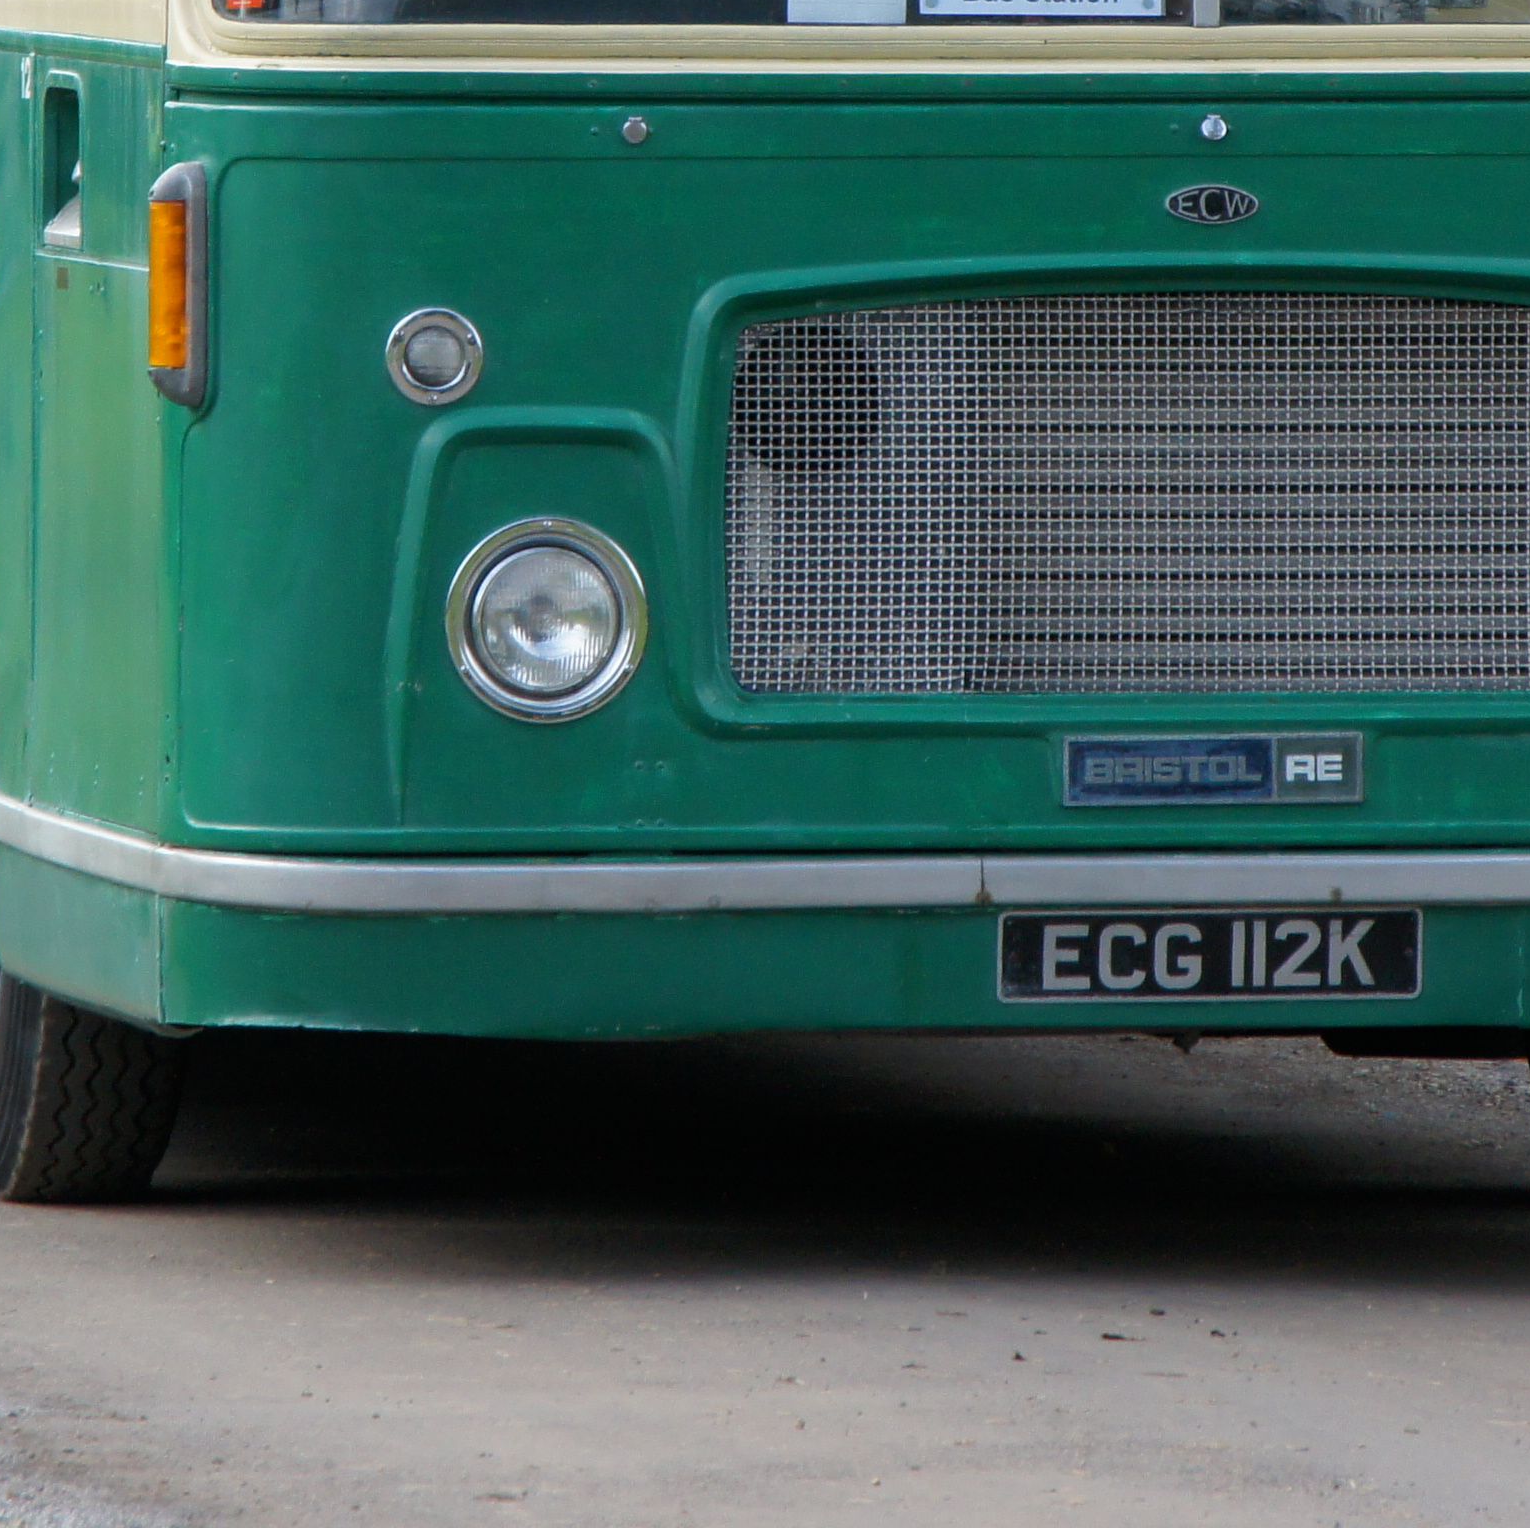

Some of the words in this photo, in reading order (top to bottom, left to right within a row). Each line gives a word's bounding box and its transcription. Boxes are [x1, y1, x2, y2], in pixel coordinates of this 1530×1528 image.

[1176, 188, 1249, 221] ECW
[1084, 754, 1262, 785] BRISTOL
[1285, 753, 1344, 783] RE
[1041, 921, 1203, 992] ECG
[1230, 918, 1377, 988] 112K
